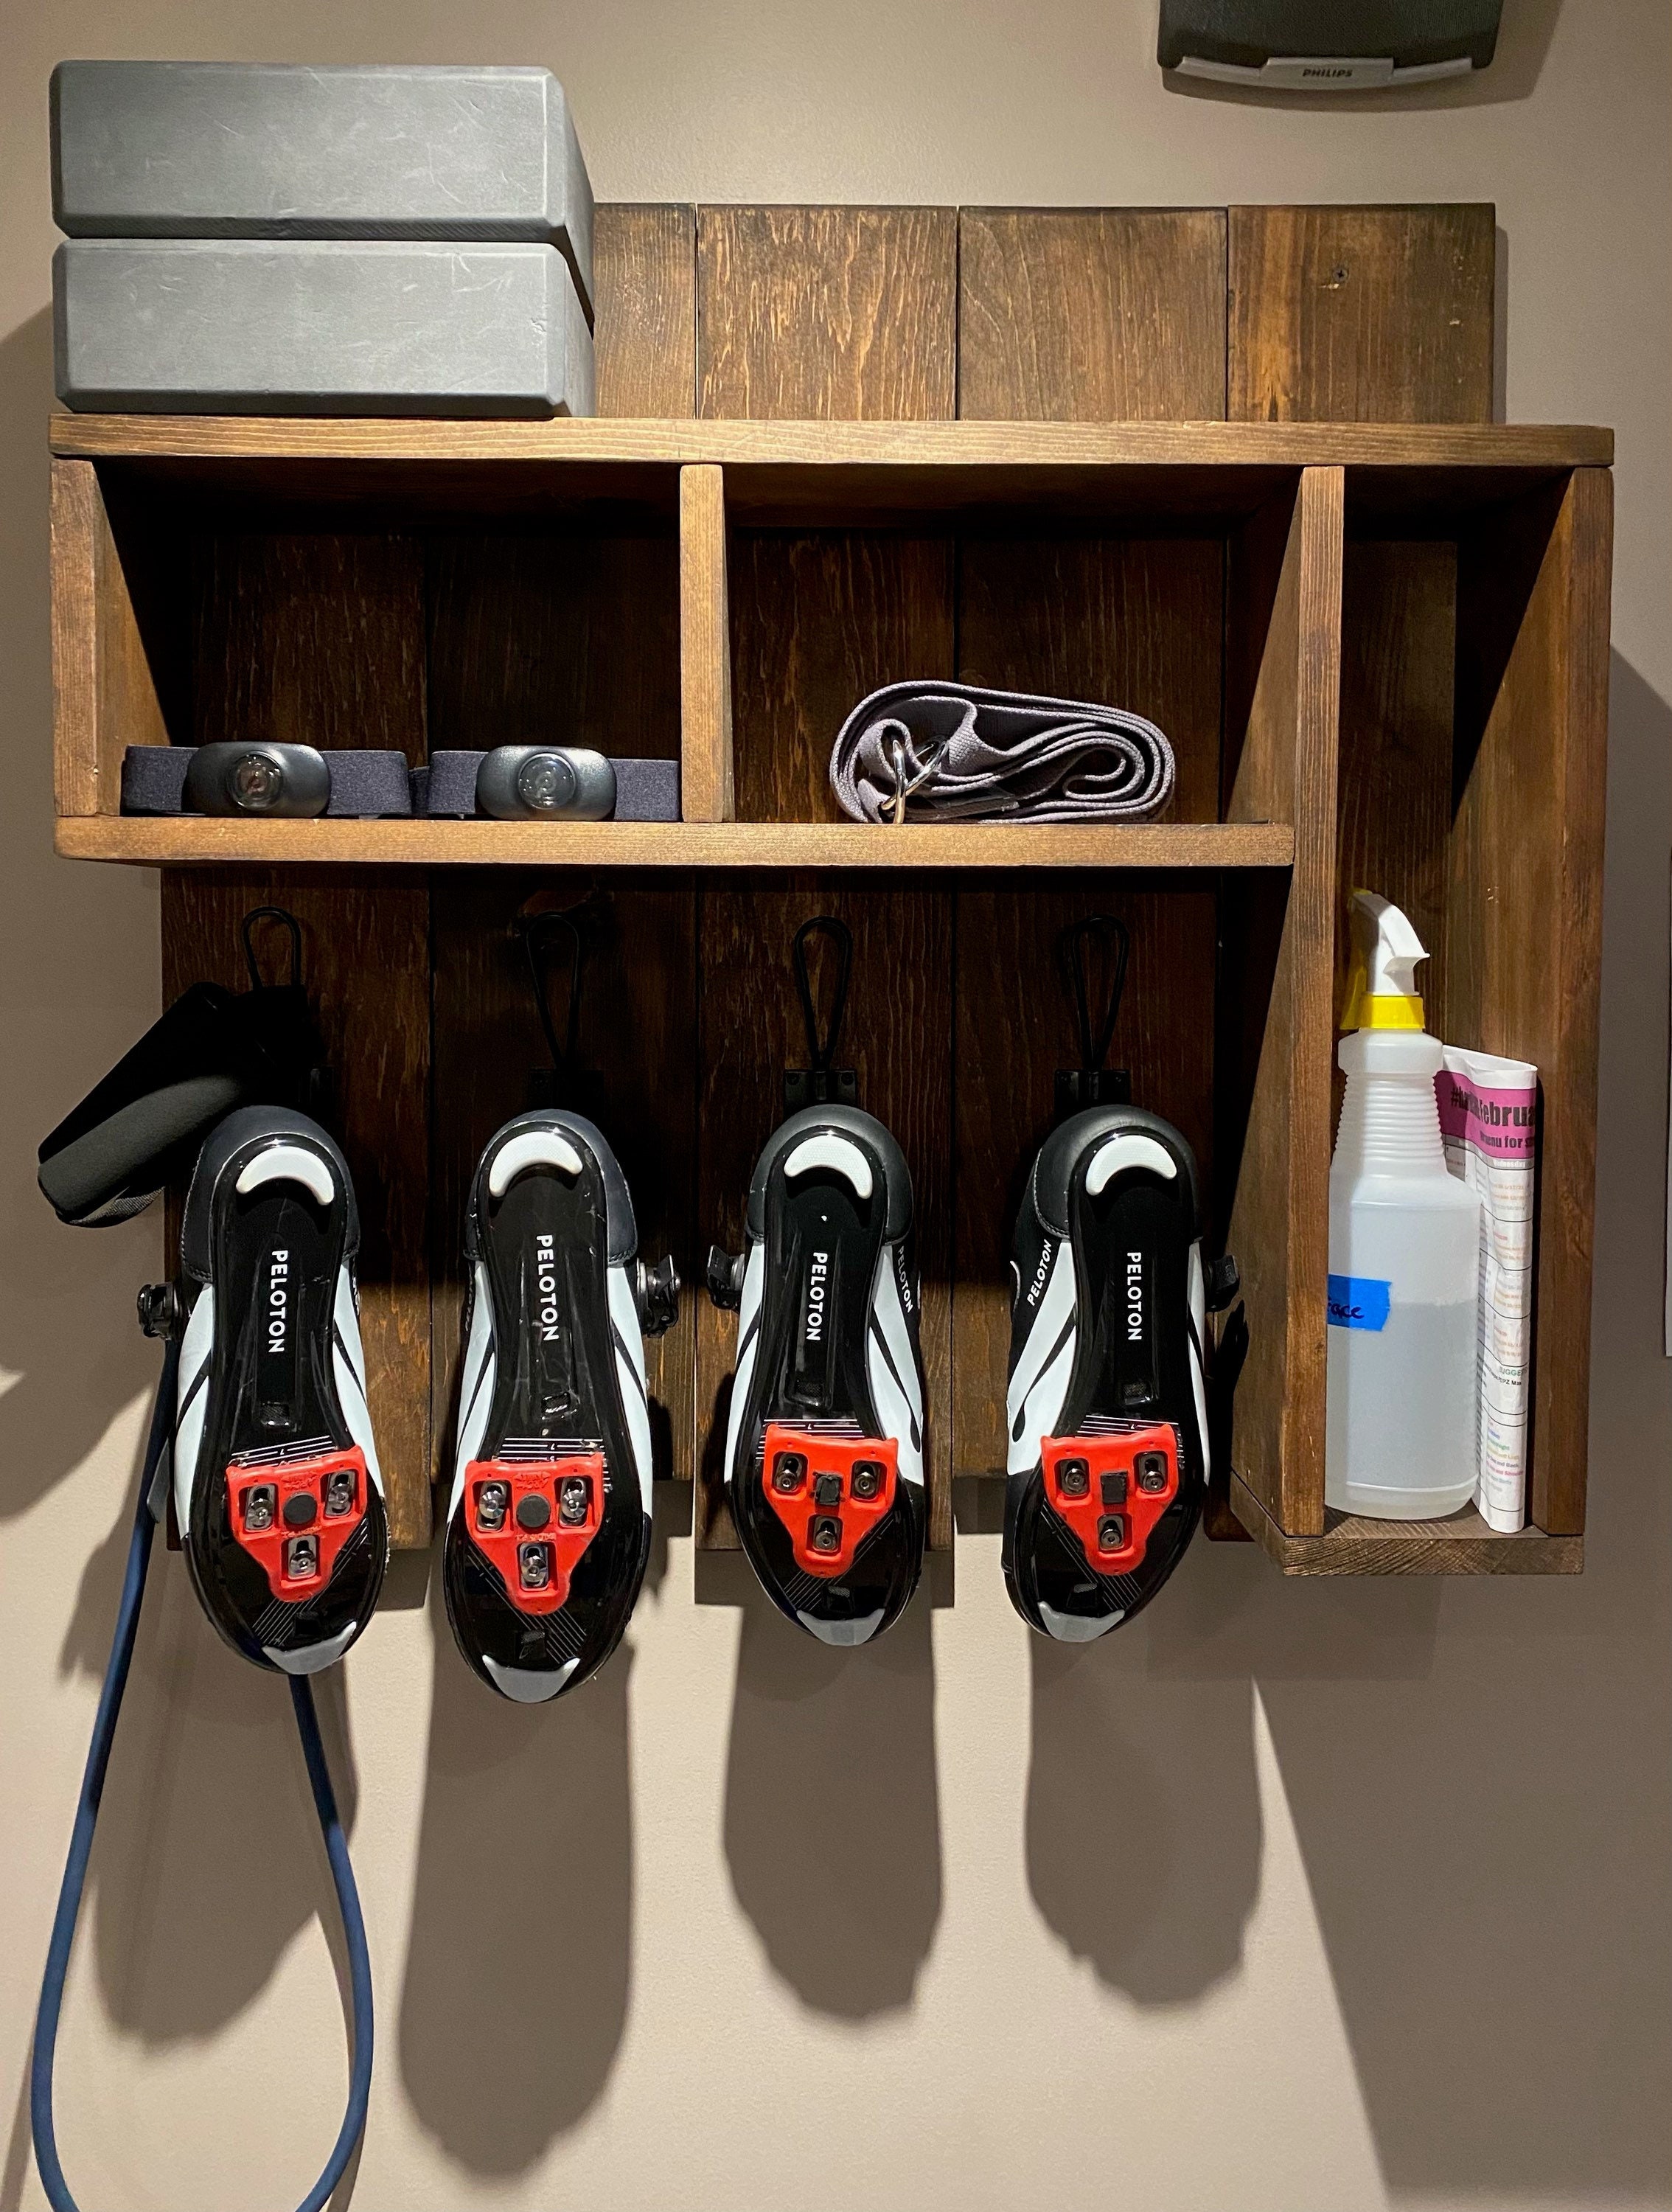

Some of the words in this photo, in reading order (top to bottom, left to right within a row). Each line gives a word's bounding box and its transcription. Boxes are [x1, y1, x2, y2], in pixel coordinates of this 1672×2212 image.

[1302, 68, 1353, 77] PHILIPS
[1505, 1135, 1523, 1148] for
[268, 1249, 289, 1353] PELOTON
[536, 1234, 560, 1341] PELOTON
[806, 1252, 829, 1341] PELOTON
[897, 1245, 914, 1313] PELOTON
[1026, 1239, 1052, 1307] PELOTON
[1126, 1252, 1143, 1340] PELOTON
